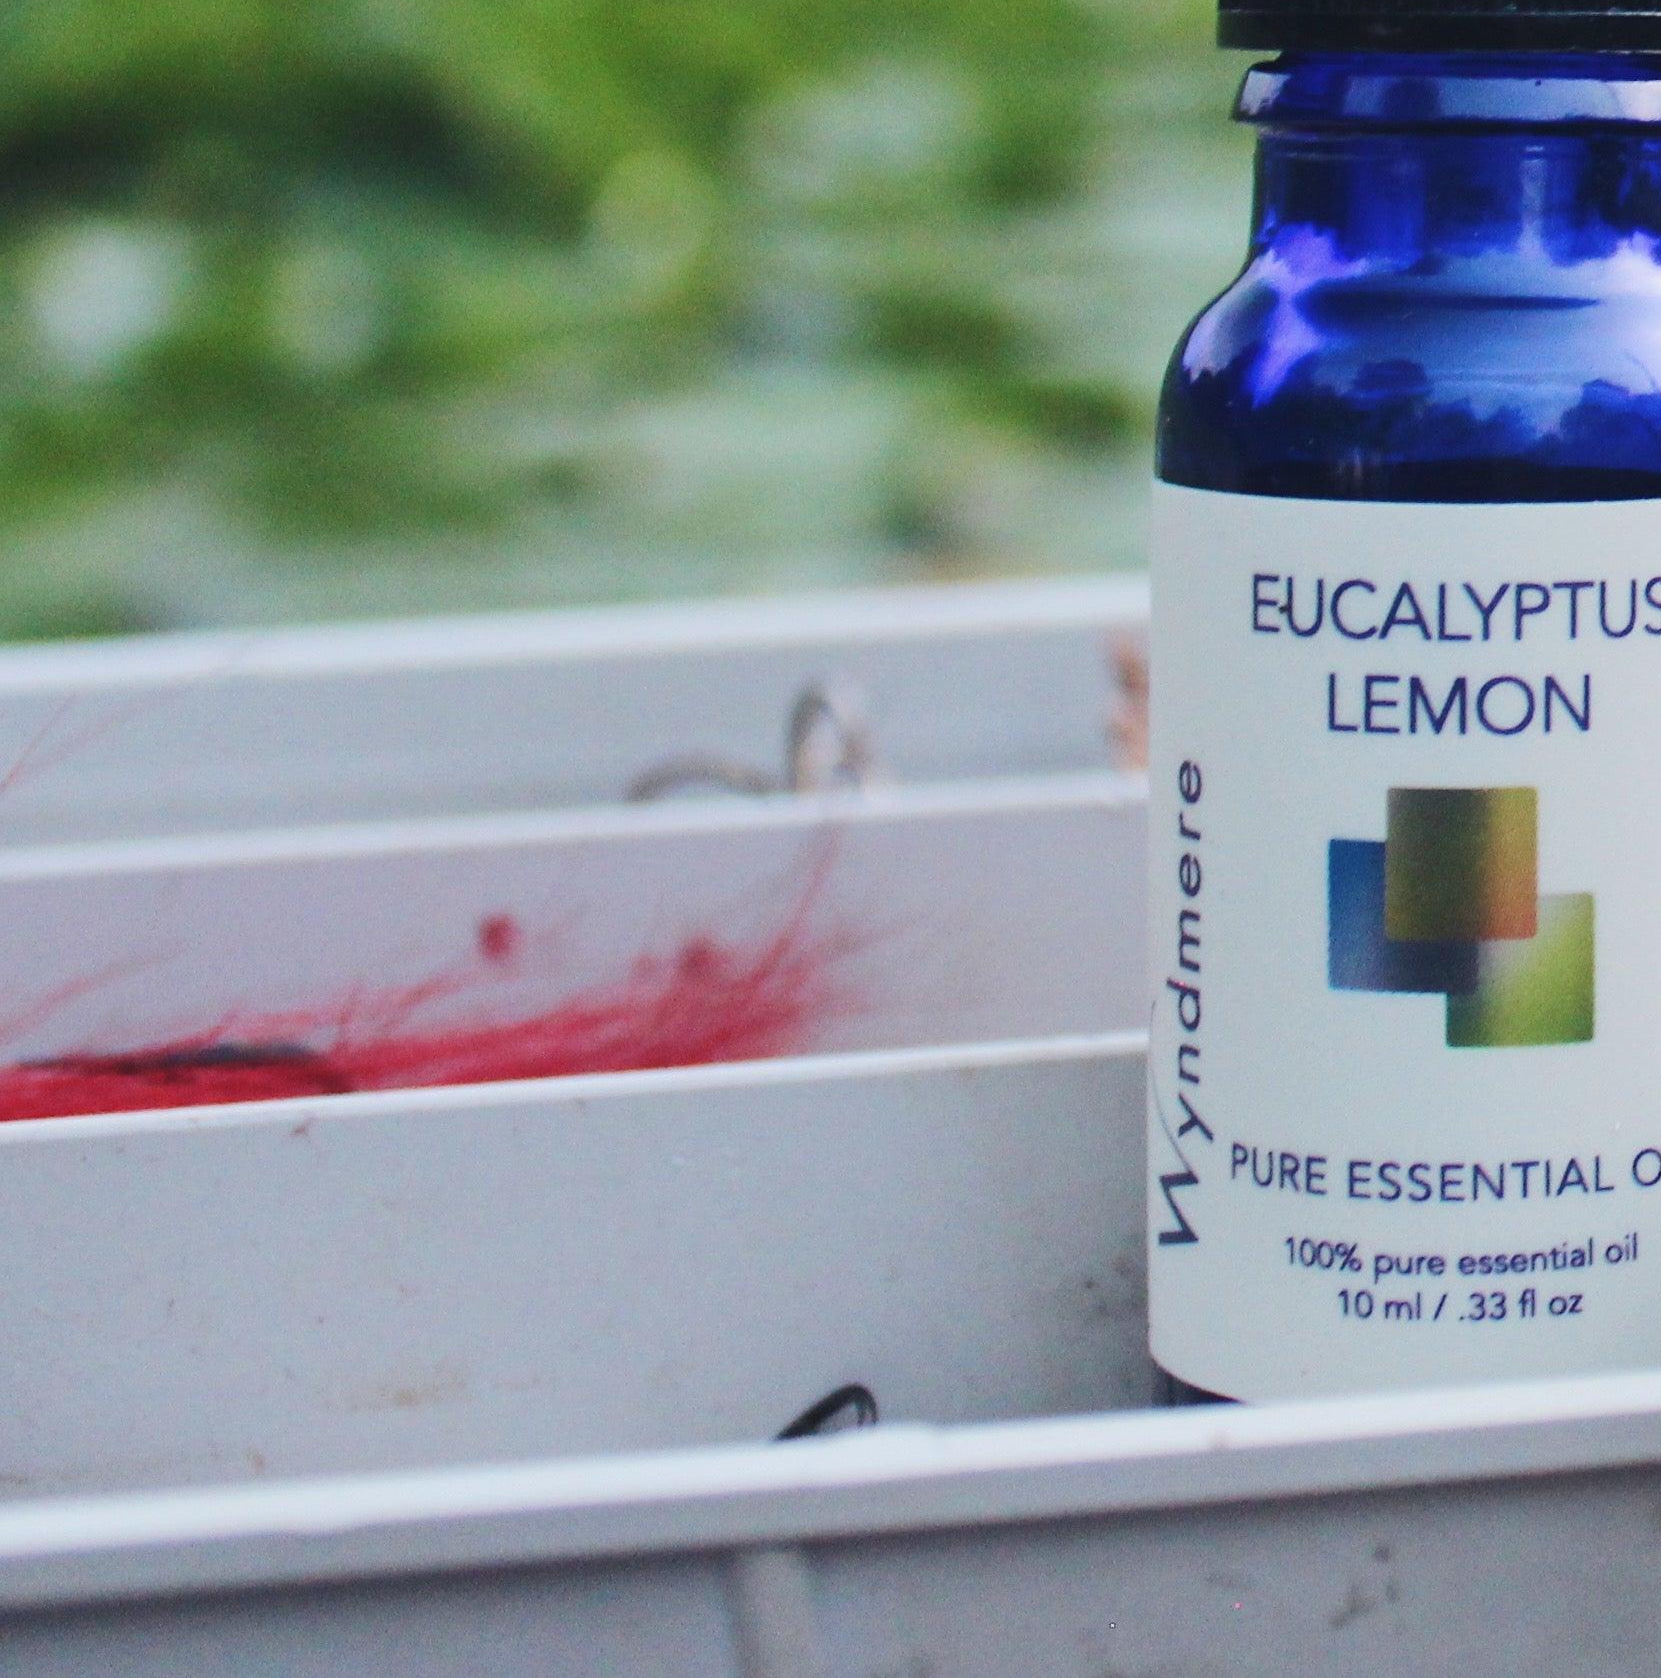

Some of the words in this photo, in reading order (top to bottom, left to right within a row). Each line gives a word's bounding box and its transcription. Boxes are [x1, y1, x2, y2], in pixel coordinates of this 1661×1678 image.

[1326, 672, 1592, 737] LEMON
[1154, 759, 1215, 1248] Wyndmere
[1230, 1141, 1328, 1198] PURE
[1346, 1155, 1615, 1205] ESSENTIAL
[1284, 1236, 1363, 1273] 100%
[1372, 1253, 1447, 1285] pure
[1455, 1236, 1595, 1278] essential
[1603, 1231, 1639, 1266] oil
[1337, 1288, 1375, 1321] 10
[1382, 1291, 1423, 1322] ml
[1431, 1293, 1448, 1323] /
[1457, 1291, 1508, 1324] .33
[1517, 1288, 1537, 1320] fl
[1546, 1293, 1584, 1318] oz
